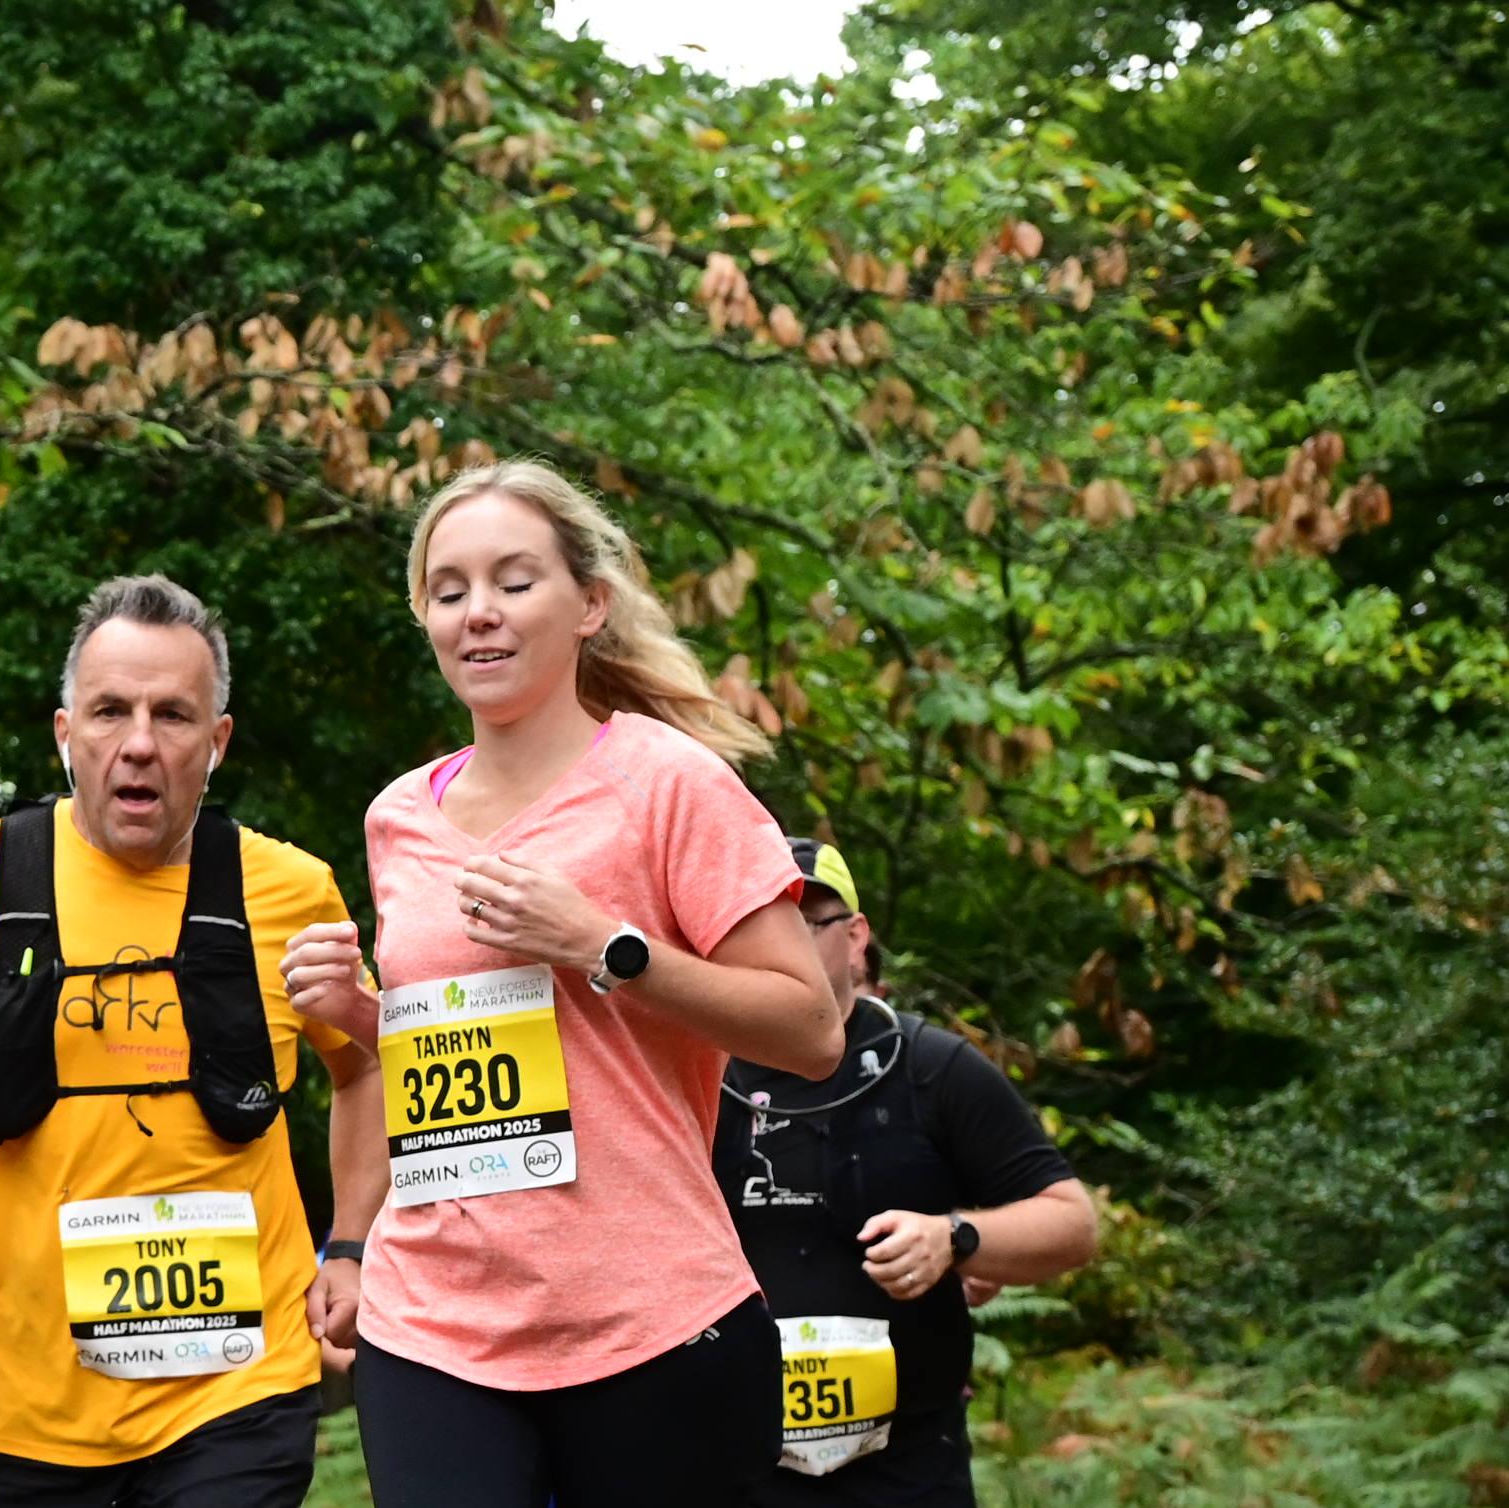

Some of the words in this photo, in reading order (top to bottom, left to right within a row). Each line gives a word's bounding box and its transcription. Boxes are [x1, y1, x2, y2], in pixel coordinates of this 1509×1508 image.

[470, 985, 498, 999] NEW
[499, 977, 543, 993] FOREST
[470, 989, 544, 1009] MARATHON
[384, 1000, 429, 1022] GARMIN
[413, 1026, 492, 1059] TARRYN
[403, 1053, 521, 1125] 3230
[401, 1135, 424, 1153] HALF
[424, 1125, 502, 1149] MARATHON
[504, 1118, 542, 1136] 2025
[469, 1153, 508, 1174] ORA
[528, 1153, 558, 1166] RAFT
[394, 1164, 459, 1189] GARMIN
[68, 1212, 141, 1229] GARMIN
[135, 1237, 187, 1260] TONY
[103, 1260, 225, 1315] 2005
[93, 1322, 128, 1337] HALF
[129, 1317, 205, 1334] MARATHON
[207, 1315, 237, 1328] 2025
[225, 1344, 250, 1354] RAFT
[782, 1357, 830, 1375] ANDY
[788, 1377, 854, 1421] 351
